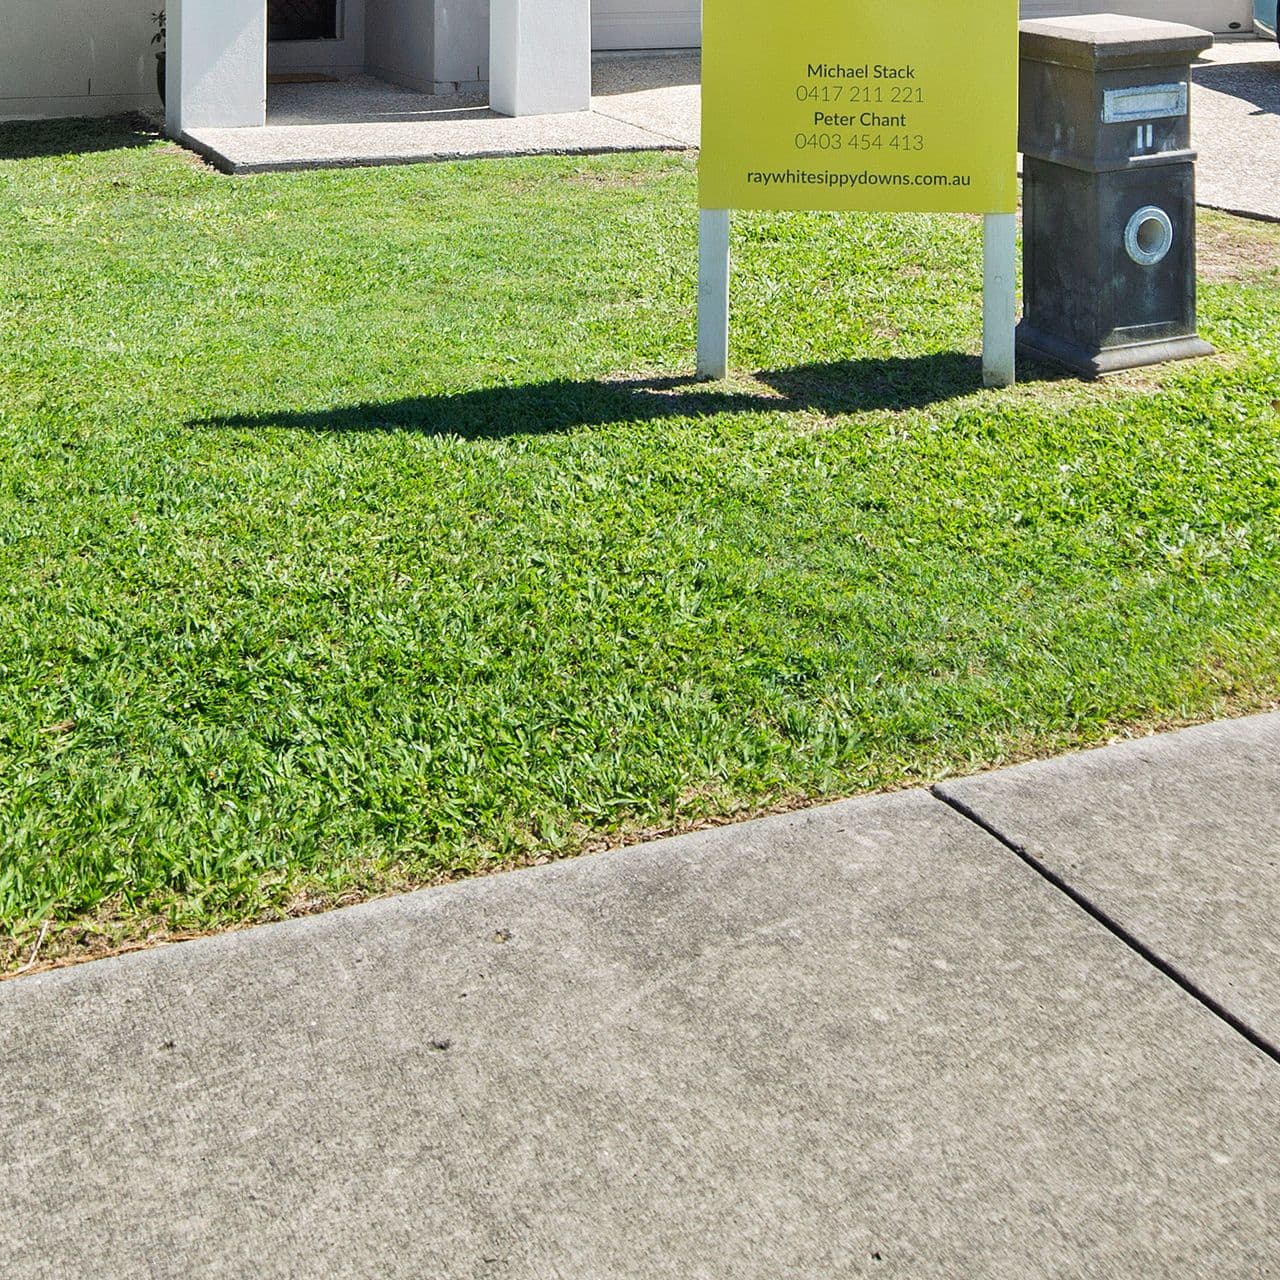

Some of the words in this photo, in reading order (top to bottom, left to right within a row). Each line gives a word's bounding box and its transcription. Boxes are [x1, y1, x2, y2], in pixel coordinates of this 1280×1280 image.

[807, 63, 869, 79] Michael
[872, 64, 916, 79] Stack
[795, 84, 844, 102] 0417
[849, 85, 884, 103] 211
[890, 86, 926, 103] 221
[814, 111, 856, 127] Peter
[859, 112, 907, 127] Chant
[794, 132, 842, 150] 0403
[847, 133, 884, 151] 454
[888, 134, 925, 151] 413
[746, 168, 971, 188] raywhitesippydowns.com.au
